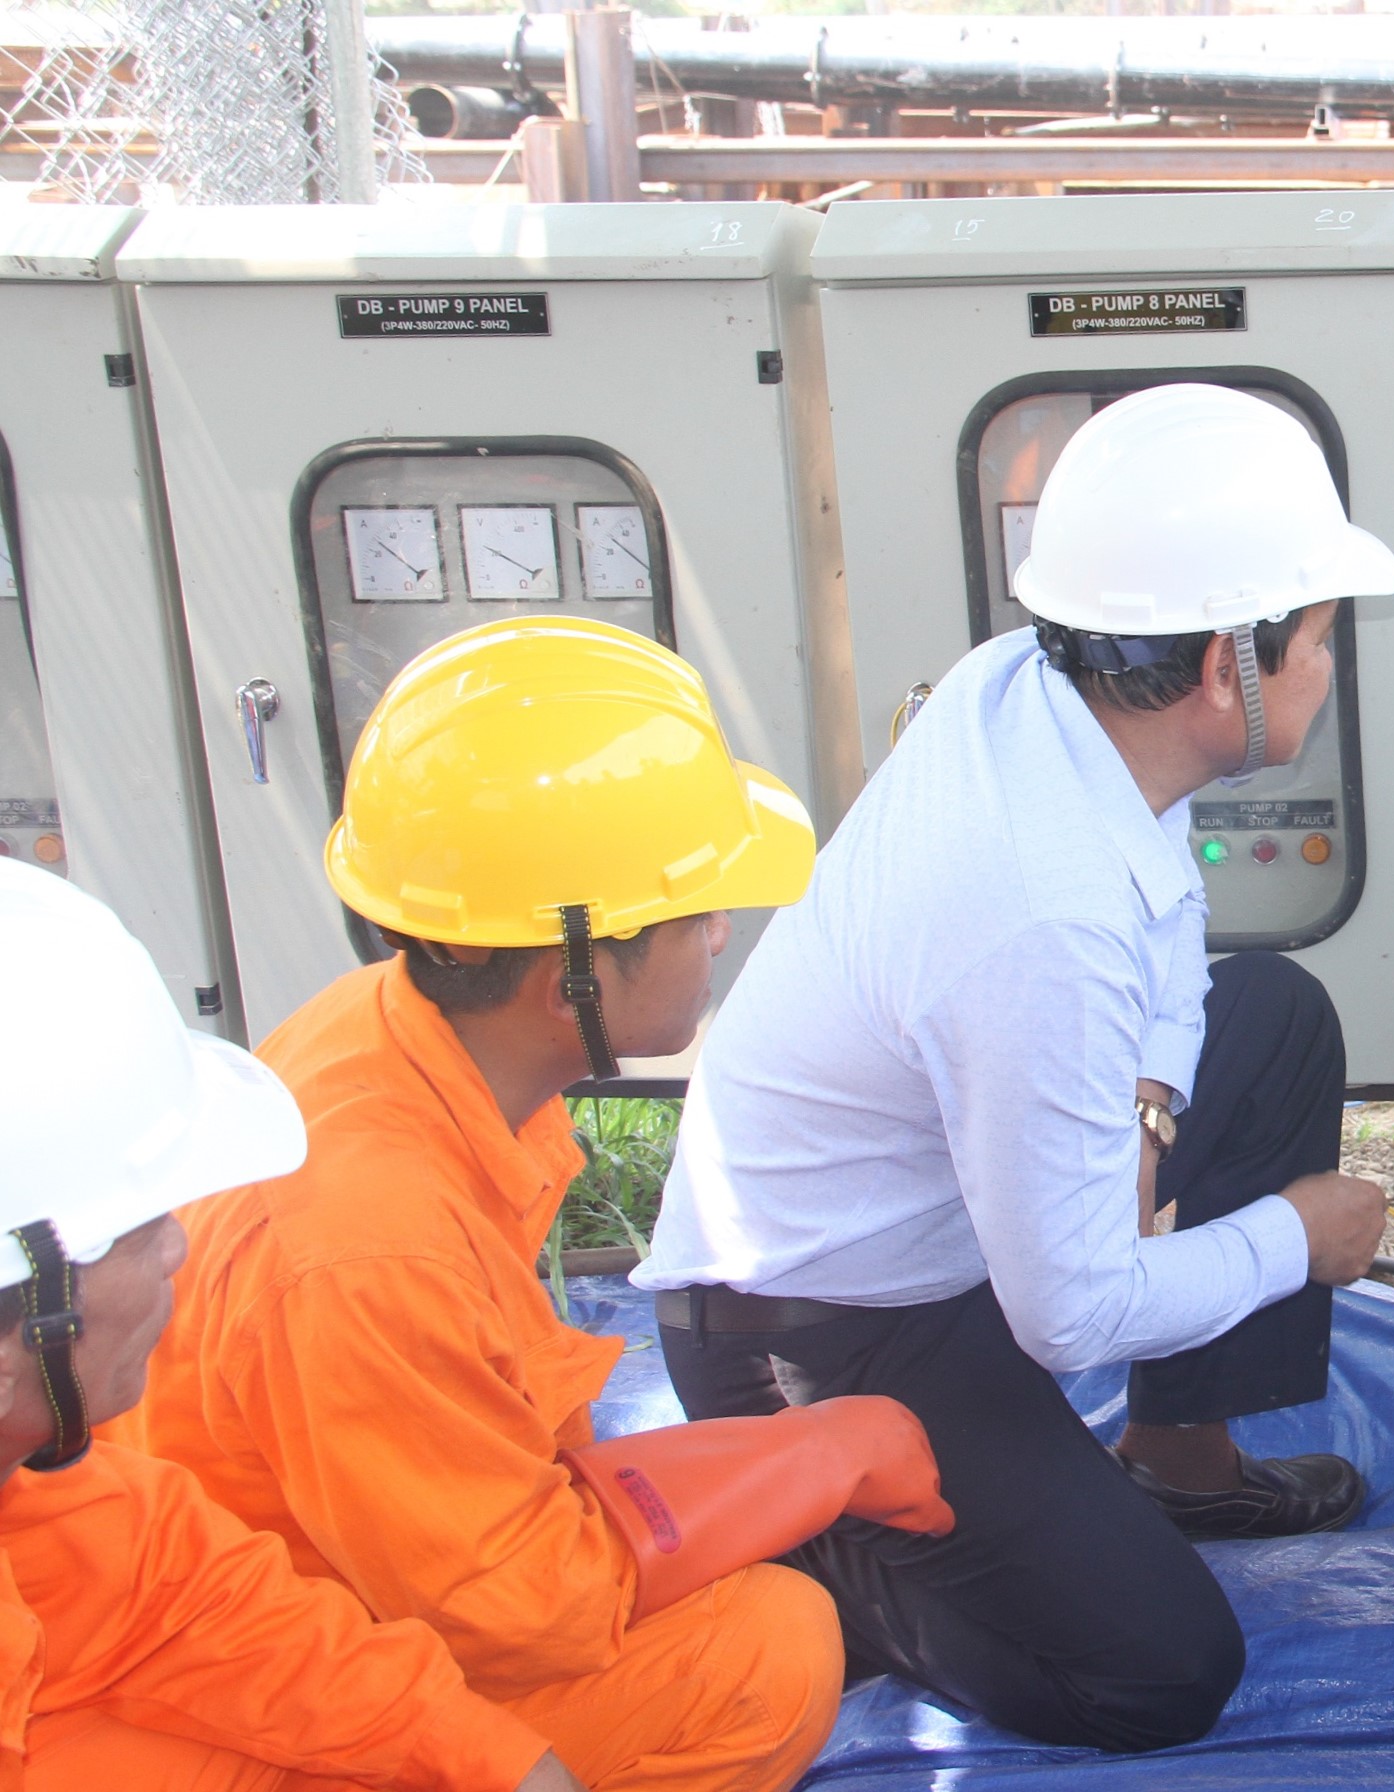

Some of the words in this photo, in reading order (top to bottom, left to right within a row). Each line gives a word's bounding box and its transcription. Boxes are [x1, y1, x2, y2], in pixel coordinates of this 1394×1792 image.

[1315, 209, 1354, 223] 20
[711, 221, 742, 241] 18
[955, 219, 985, 235] 15
[357, 300, 383, 314] DB
[399, 300, 450, 314] PUMP
[454, 299, 464, 314] 9
[470, 298, 529, 314] PANEL
[1049, 298, 1075, 312] DB
[1092, 296, 1144, 312] PUMP
[1148, 295, 1159, 310] 8
[1164, 293, 1226, 310] PANEL
[480, 320, 510, 331] 50HZ)
[1174, 315, 1206, 328] 50HZ)
[1240, 804, 1272, 812] PUMP
[1276, 804, 1288, 812] 02
[1200, 818, 1224, 827] RUN
[1248, 816, 1278, 826] STOP
[1294, 816, 1330, 825] FAULT
